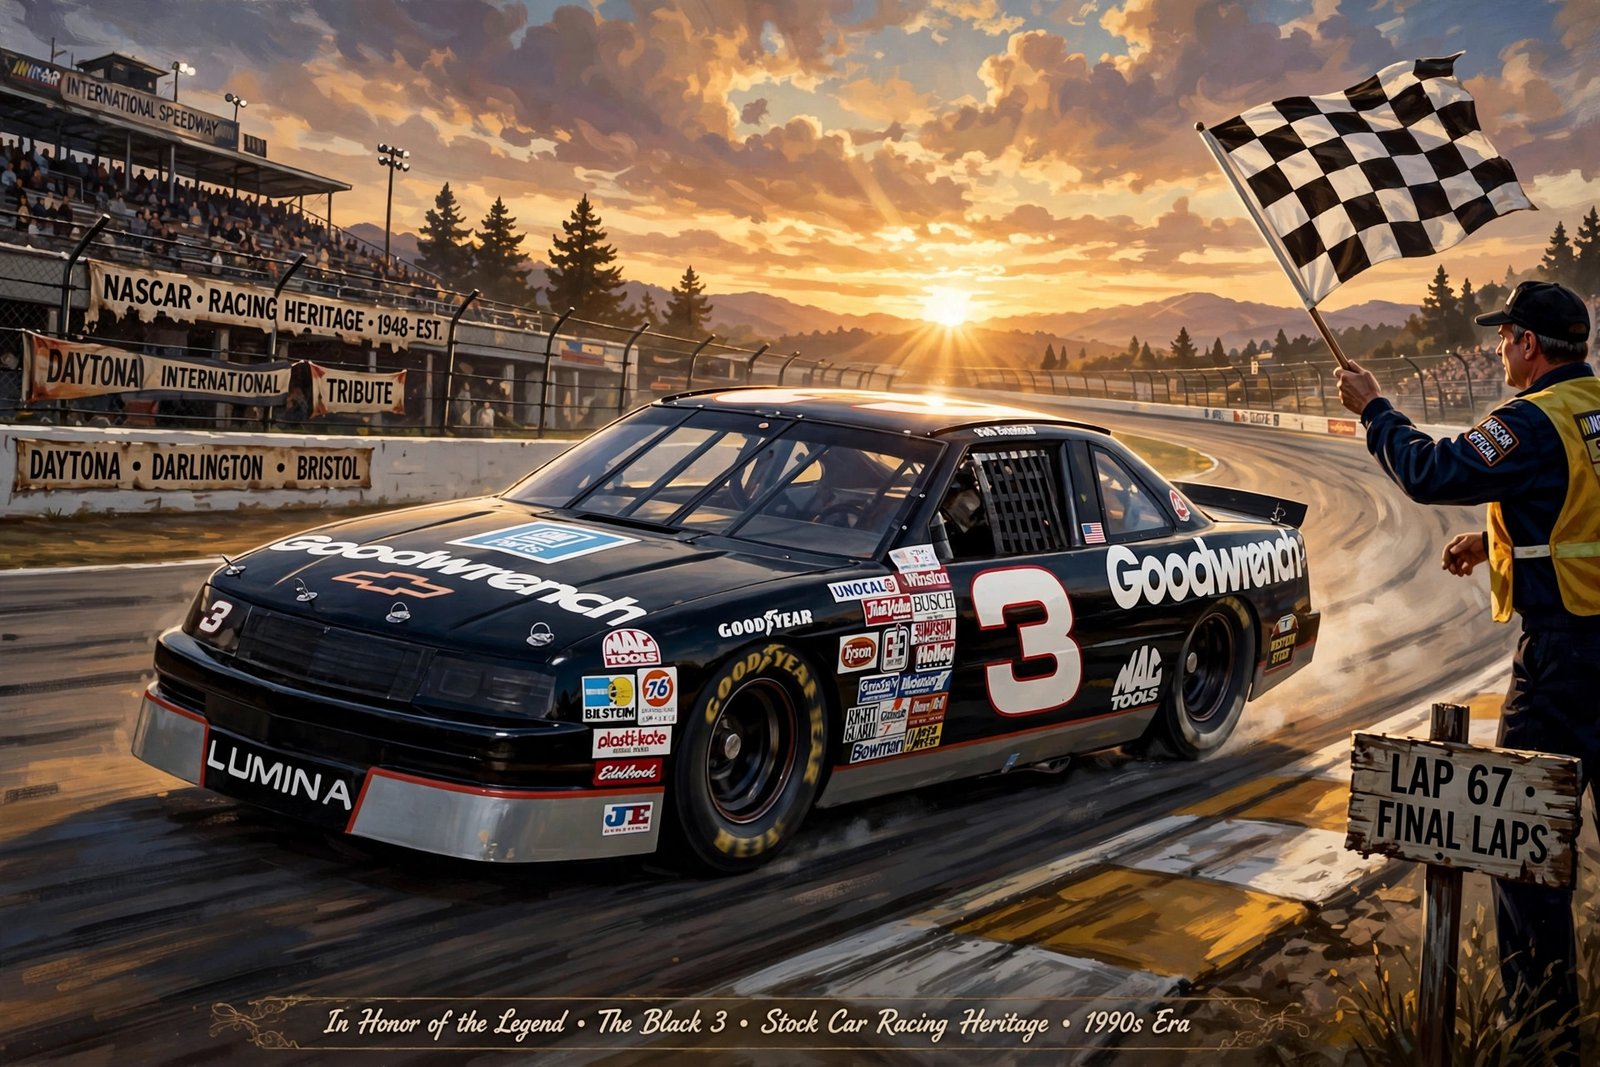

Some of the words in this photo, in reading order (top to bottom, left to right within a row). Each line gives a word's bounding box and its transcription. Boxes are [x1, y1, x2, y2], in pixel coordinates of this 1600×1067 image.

[66, 76, 155, 118] INTERNATIONAL
[159, 104, 219, 136] SPEEDWAY
[104, 274, 192, 310] NASCAR
[208, 288, 277, 321] RACING
[284, 300, 364, 332] HERITAGE
[377, 314, 443, 341] 1948-EST.
[46, 348, 140, 388] DAYTONA
[160, 364, 281, 394] INTERNATIONAL
[326, 377, 394, 405] TRIBUTE
[1482, 418, 1513, 449] NASCAR
[29, 449, 121, 481] DAYTONA
[151, 452, 263, 481] DARLINGTON
[296, 454, 361, 481] BRISTOL
[268, 534, 647, 627] Goodwrench
[904, 572, 950, 588] Winston
[1106, 527, 1303, 610] Goodwrench
[832, 580, 886, 598] UNOCAL
[912, 592, 955, 613] BUSCH
[199, 600, 233, 633] 3
[606, 630, 657, 654] MAC
[844, 644, 872, 664] Tyson
[973, 566, 1082, 717] 3
[607, 652, 657, 664] TOOLS
[1112, 645, 1163, 696] MAC
[645, 676, 670, 700] 76
[1110, 687, 1159, 711] TOOLS
[852, 739, 904, 762] Bowman
[207, 739, 353, 811] LUMINA
[1390, 752, 1454, 799] LAP
[1467, 763, 1513, 808] 67
[605, 804, 651, 828] JE
[1376, 799, 1461, 850] FINAL
[1472, 815, 1548, 864] LAPS
